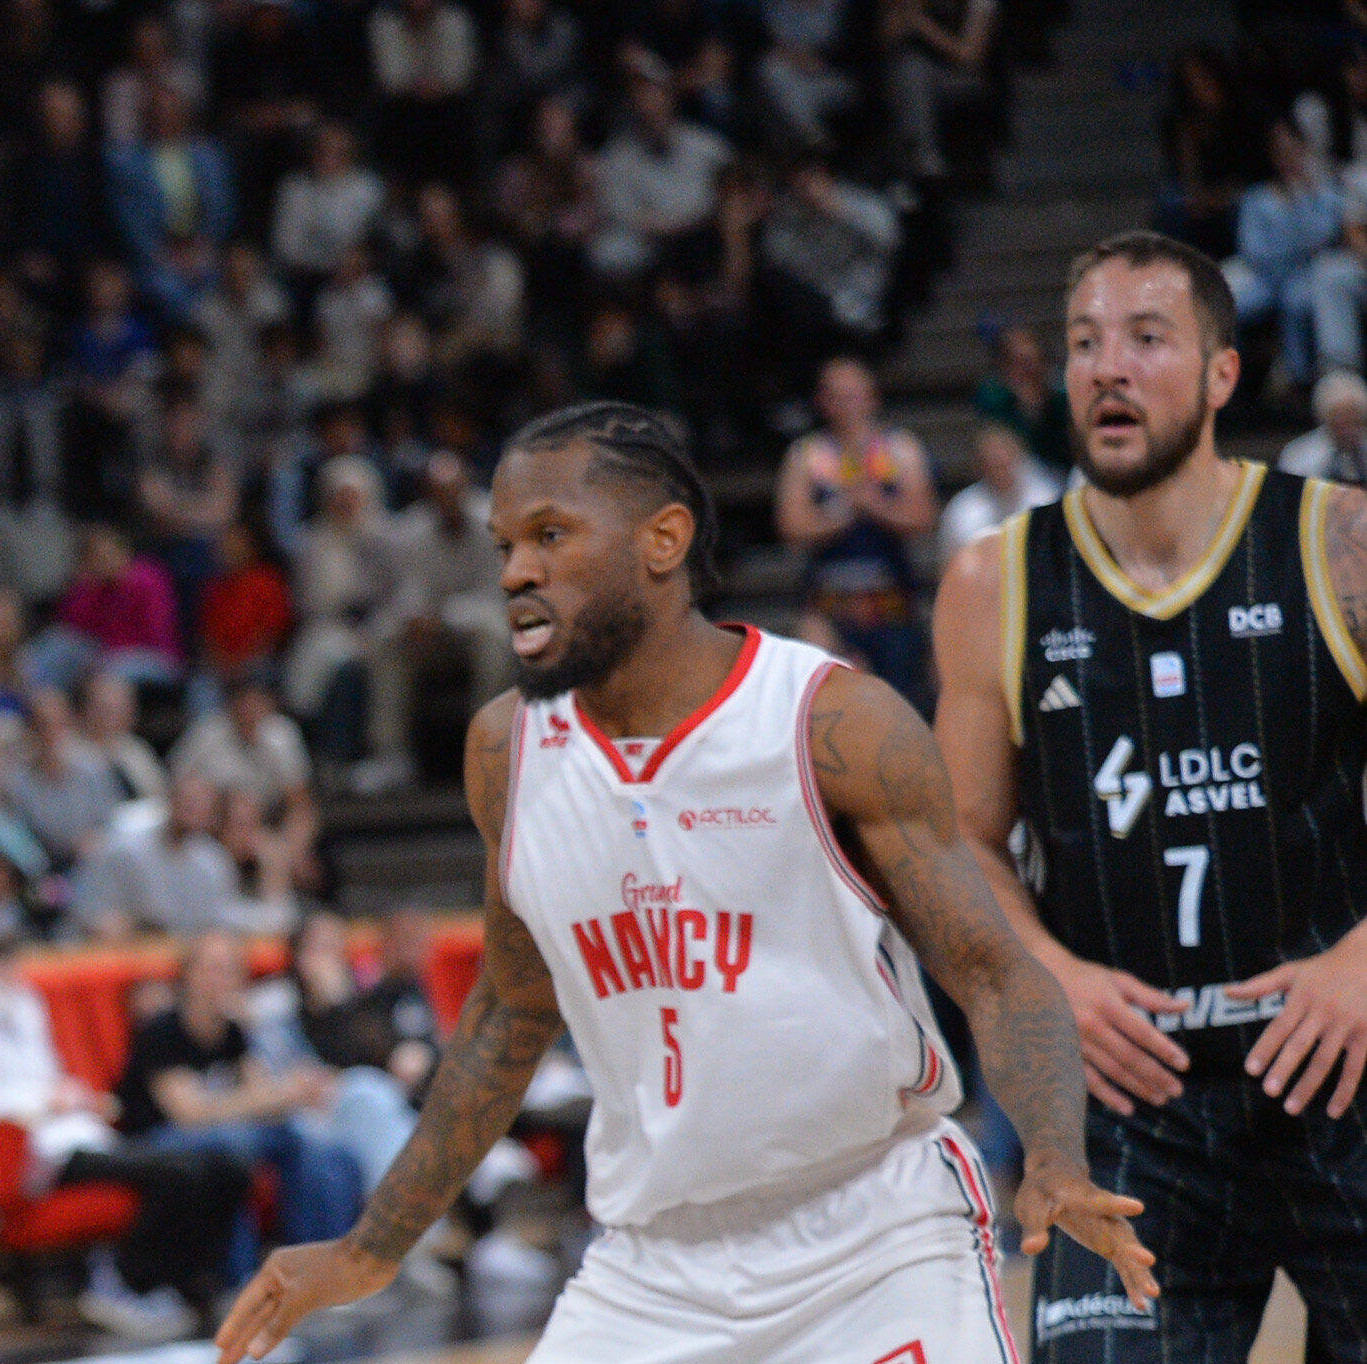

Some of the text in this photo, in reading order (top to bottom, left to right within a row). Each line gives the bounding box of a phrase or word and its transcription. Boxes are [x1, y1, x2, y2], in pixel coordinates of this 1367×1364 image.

[1228, 604, 1282, 633] DCB
[1159, 742, 1261, 788] LDLC
[1164, 782, 1266, 817] ASVEL
[1164, 846, 1209, 947] 7
[570, 908, 753, 1000] NANCY
[660, 1007, 682, 1107] 5
